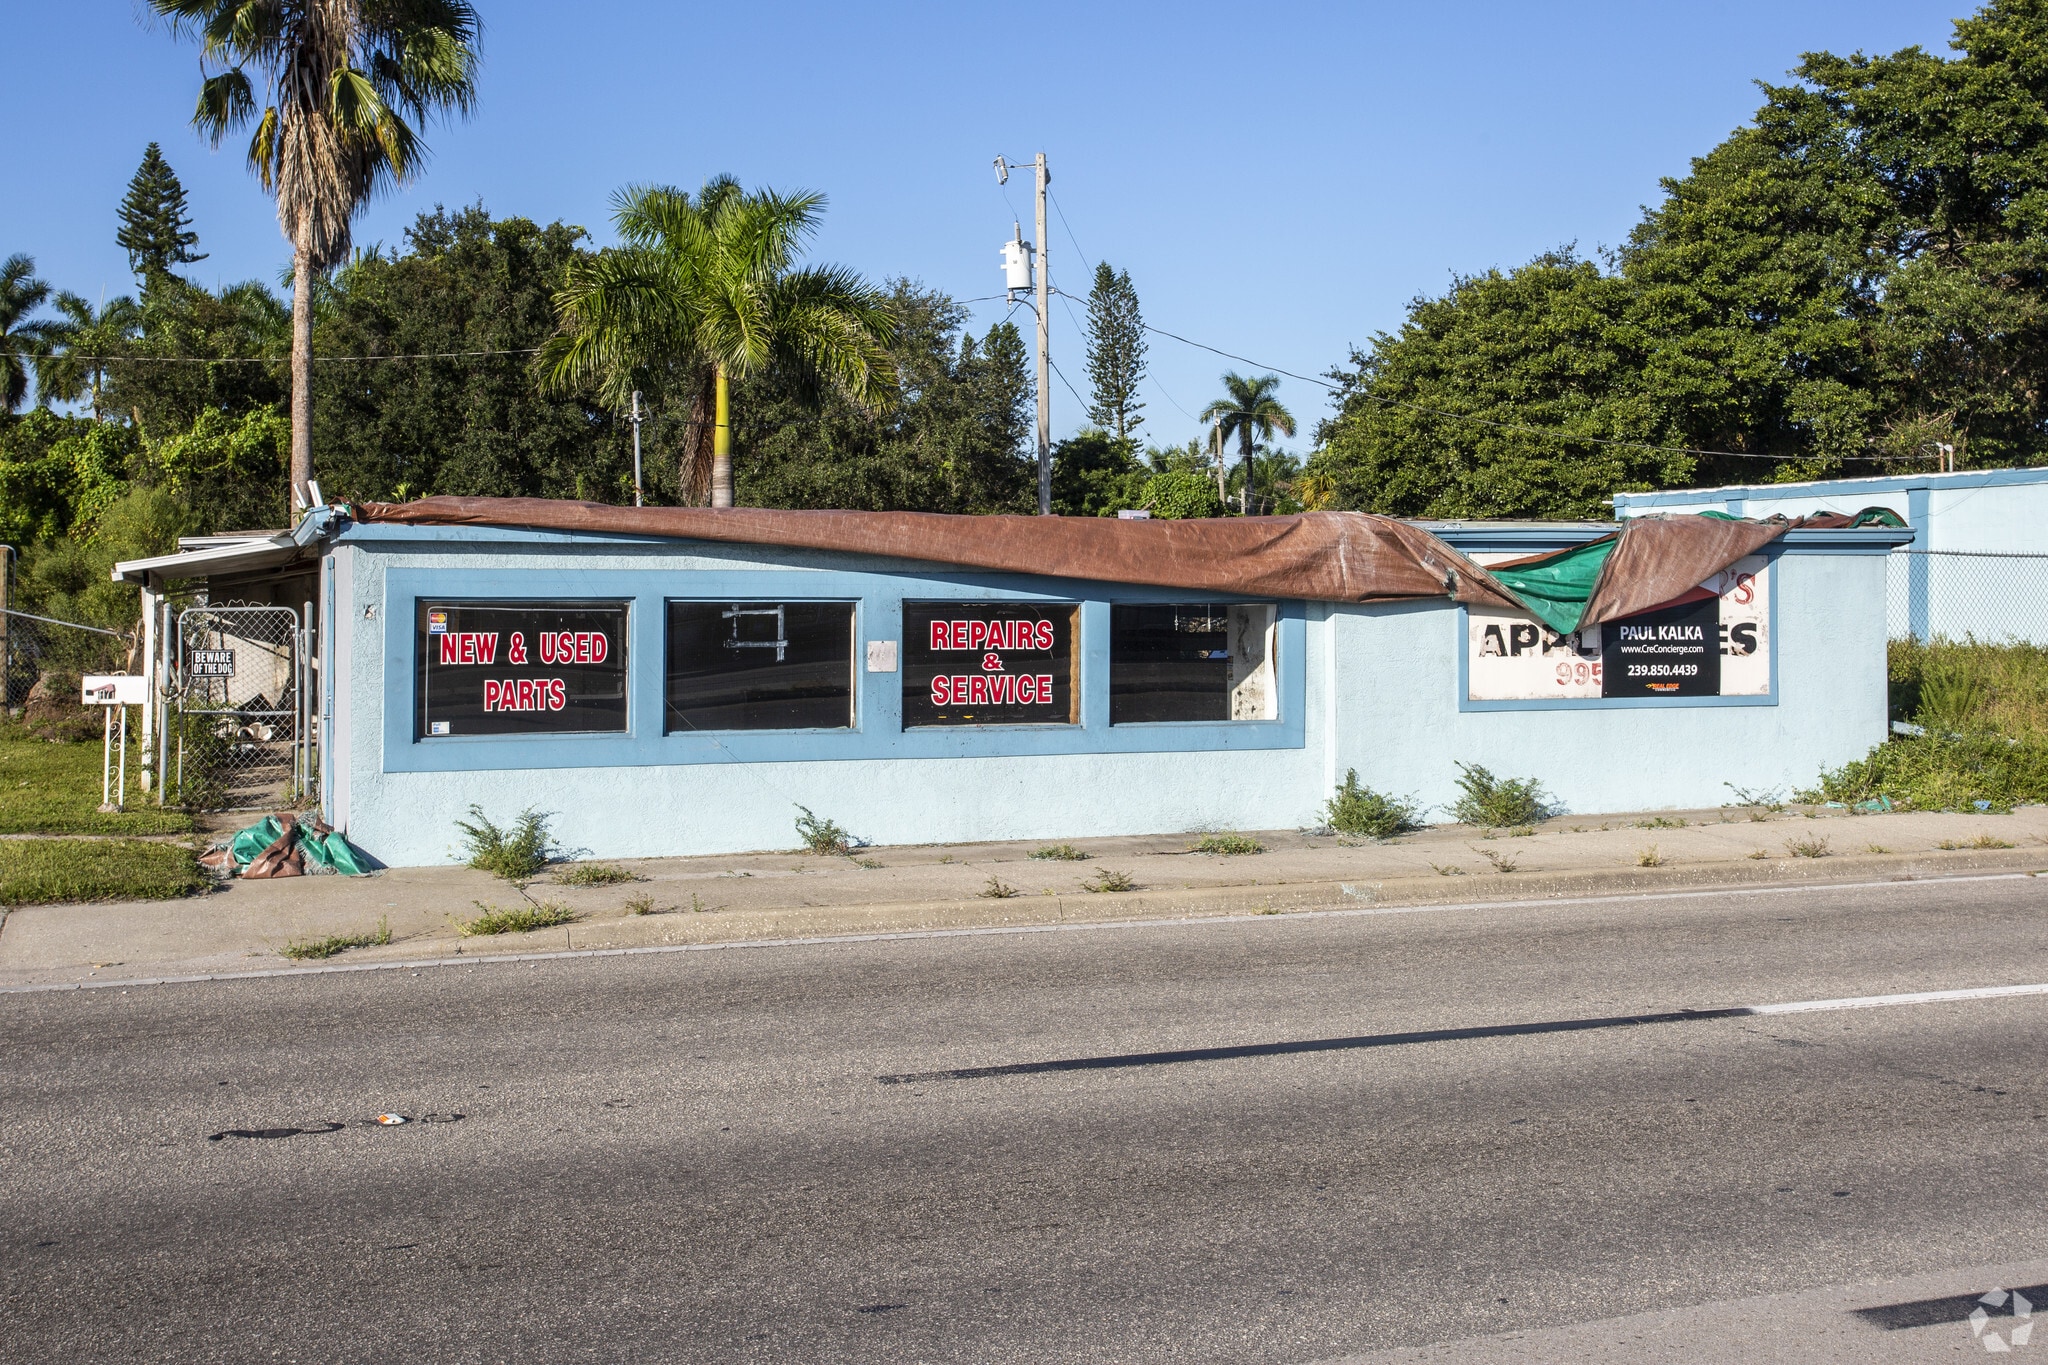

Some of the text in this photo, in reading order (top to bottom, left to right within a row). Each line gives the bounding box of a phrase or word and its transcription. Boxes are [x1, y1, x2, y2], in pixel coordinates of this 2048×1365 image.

[930, 619, 1054, 651] REPAIRS
[1620, 625, 1703, 641] PAUL KALKA
[440, 631, 608, 665] NEW & USED
[1621, 644, 1704, 655] www.CreConcierge.com
[195, 652, 231, 663] BEWARE
[981, 652, 1005, 672] &
[193, 663, 232, 674] OF THE DOG
[1627, 664, 1698, 676] 239.850.4439
[483, 677, 566, 712] PARTS
[931, 673, 1053, 706] SERVICE
